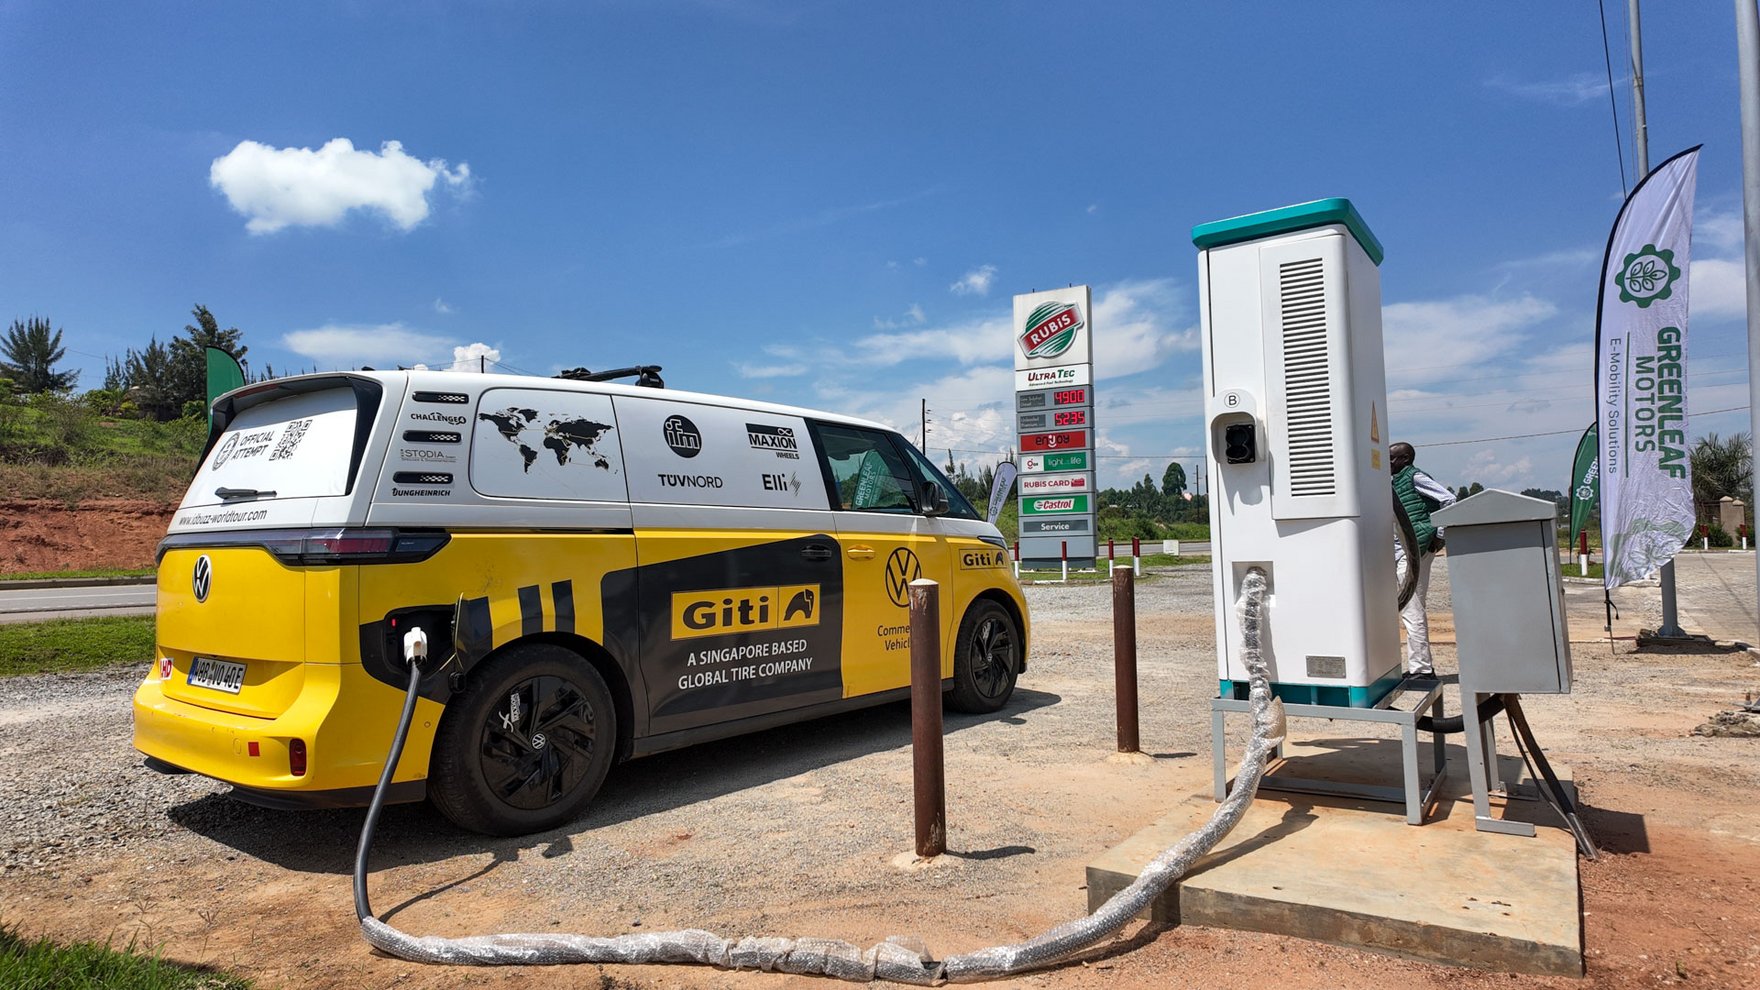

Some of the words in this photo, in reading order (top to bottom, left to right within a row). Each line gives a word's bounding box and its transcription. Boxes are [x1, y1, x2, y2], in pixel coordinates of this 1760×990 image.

[1606, 338, 1621, 407] E-Mobility
[1055, 390, 1084, 404] 4900
[1229, 395, 1237, 405] B
[1635, 355, 1656, 453] MOTORS
[1656, 326, 1686, 480] GREENLEAF
[1055, 411, 1085, 426] 5235
[240, 431, 275, 446] OFFICIAL
[748, 433, 797, 449] MAXION
[1608, 409, 1620, 474] Solutions
[231, 445, 269, 461] ATTEMPT
[776, 452, 799, 460] WHEELS
[762, 473, 788, 491] Elli
[1048, 479, 1070, 487] CARD
[1043, 499, 1072, 510] Castrol
[1041, 522, 1070, 531] Service
[963, 553, 991, 567] Giti
[682, 595, 770, 630] Giti
[878, 625, 910, 637] Comme
[885, 638, 910, 651] Vehicl
[687, 652, 697, 666] A
[700, 643, 769, 665] SINGAPORE
[772, 639, 807, 656] BASED
[678, 670, 729, 690] GLOBAL
[731, 665, 756, 681] TIRE
[758, 657, 813, 677] COMPANY
